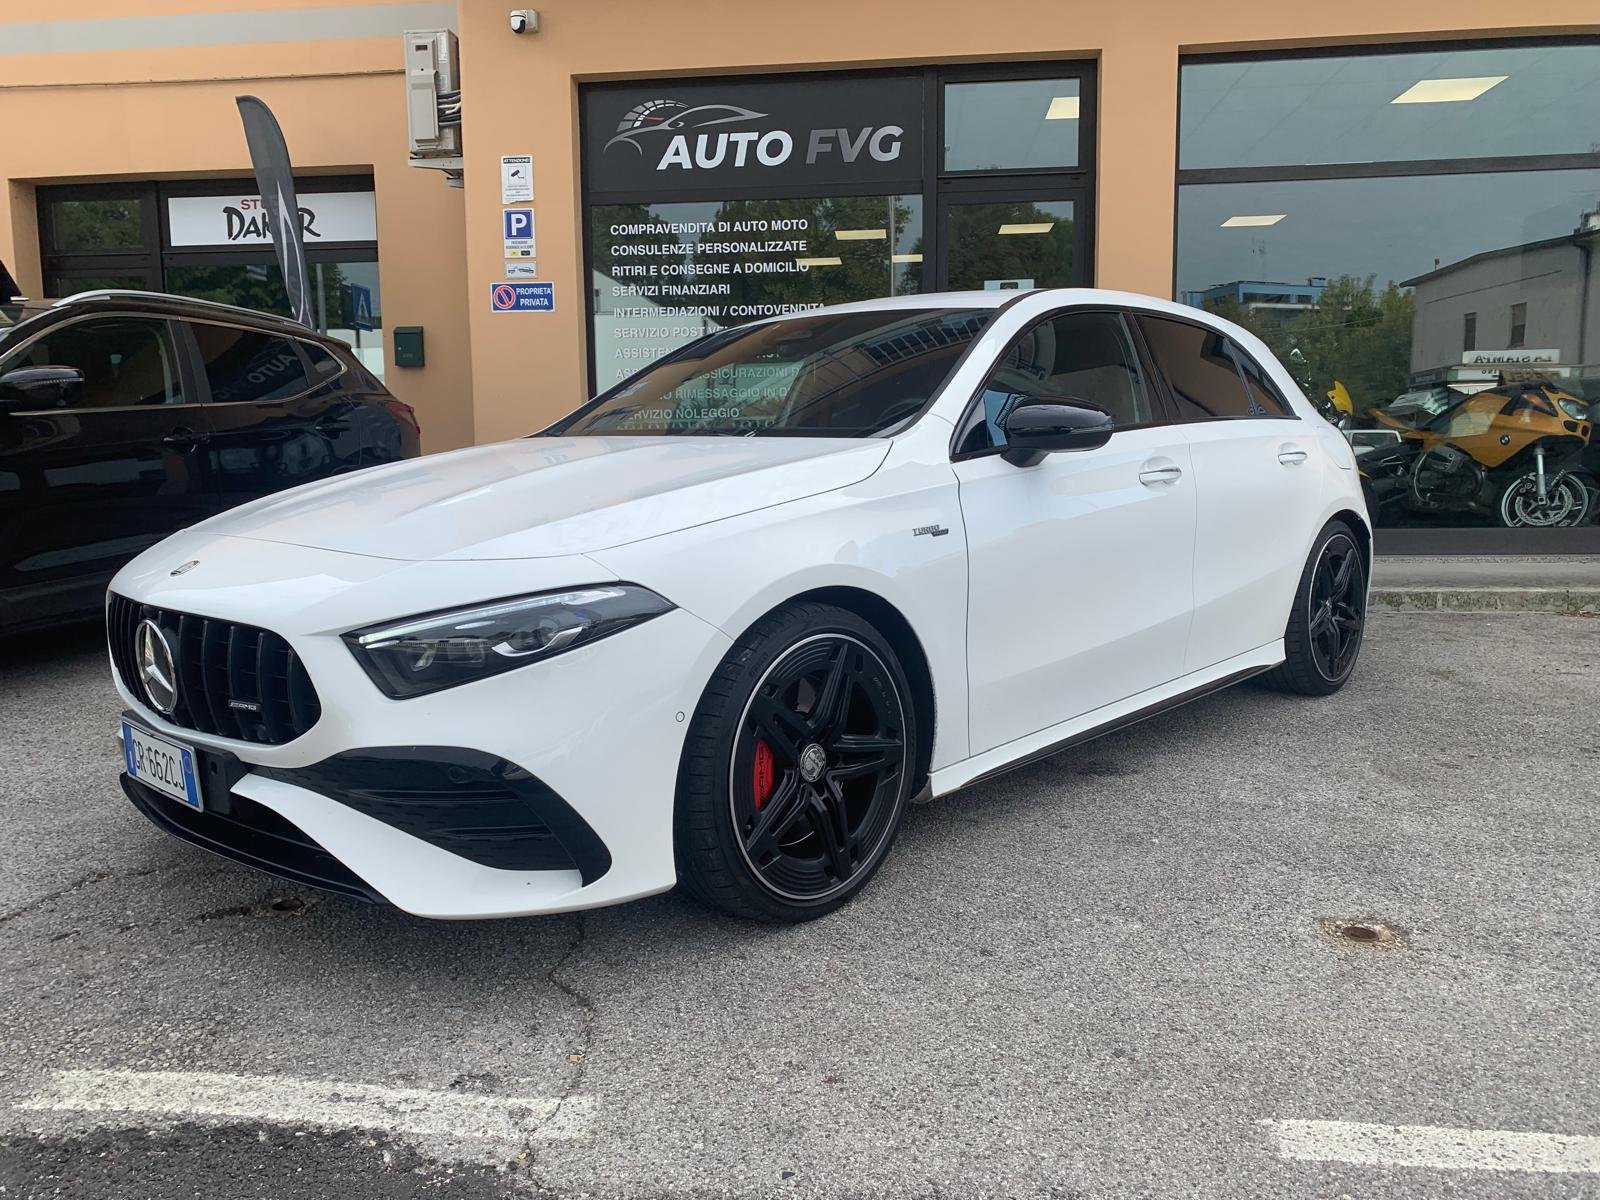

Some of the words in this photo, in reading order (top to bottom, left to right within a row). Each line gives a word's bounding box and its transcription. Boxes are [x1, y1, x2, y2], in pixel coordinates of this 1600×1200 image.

[656, 130, 793, 170] AUTO
[806, 125, 904, 164] FVG
[223, 206, 321, 241] DAKR
[510, 213, 527, 236] P
[610, 222, 715, 235] COMPRAVENDITA
[718, 221, 731, 232] DI
[733, 220, 768, 232] AUTO
[771, 219, 808, 231] MOTO
[611, 243, 694, 256] CONSULENZE
[697, 240, 807, 254] PERSONALIZZATE
[612, 265, 647, 277] RITIRI
[650, 265, 658, 276] E
[661, 263, 730, 276] CONSEGNE
[733, 263, 742, 274] A
[745, 261, 809, 274] DOMICILIO
[612, 285, 659, 297] SERVIZI
[662, 284, 731, 296] FINANZIARI
[520, 298, 549, 306] PRIVATA
[614, 305, 720, 318] INTERMEDIAZIONI
[722, 305, 727, 316] /
[614, 327, 670, 339] SERVIZIO
[673, 326, 705, 337] POST
[699, 367, 788, 379] SSICURAZIONI
[675, 387, 760, 400] RIMESSAGGIO
[676, 408, 740, 419] NOLEGGIO
[147, 746, 186, 791] 662CJ
